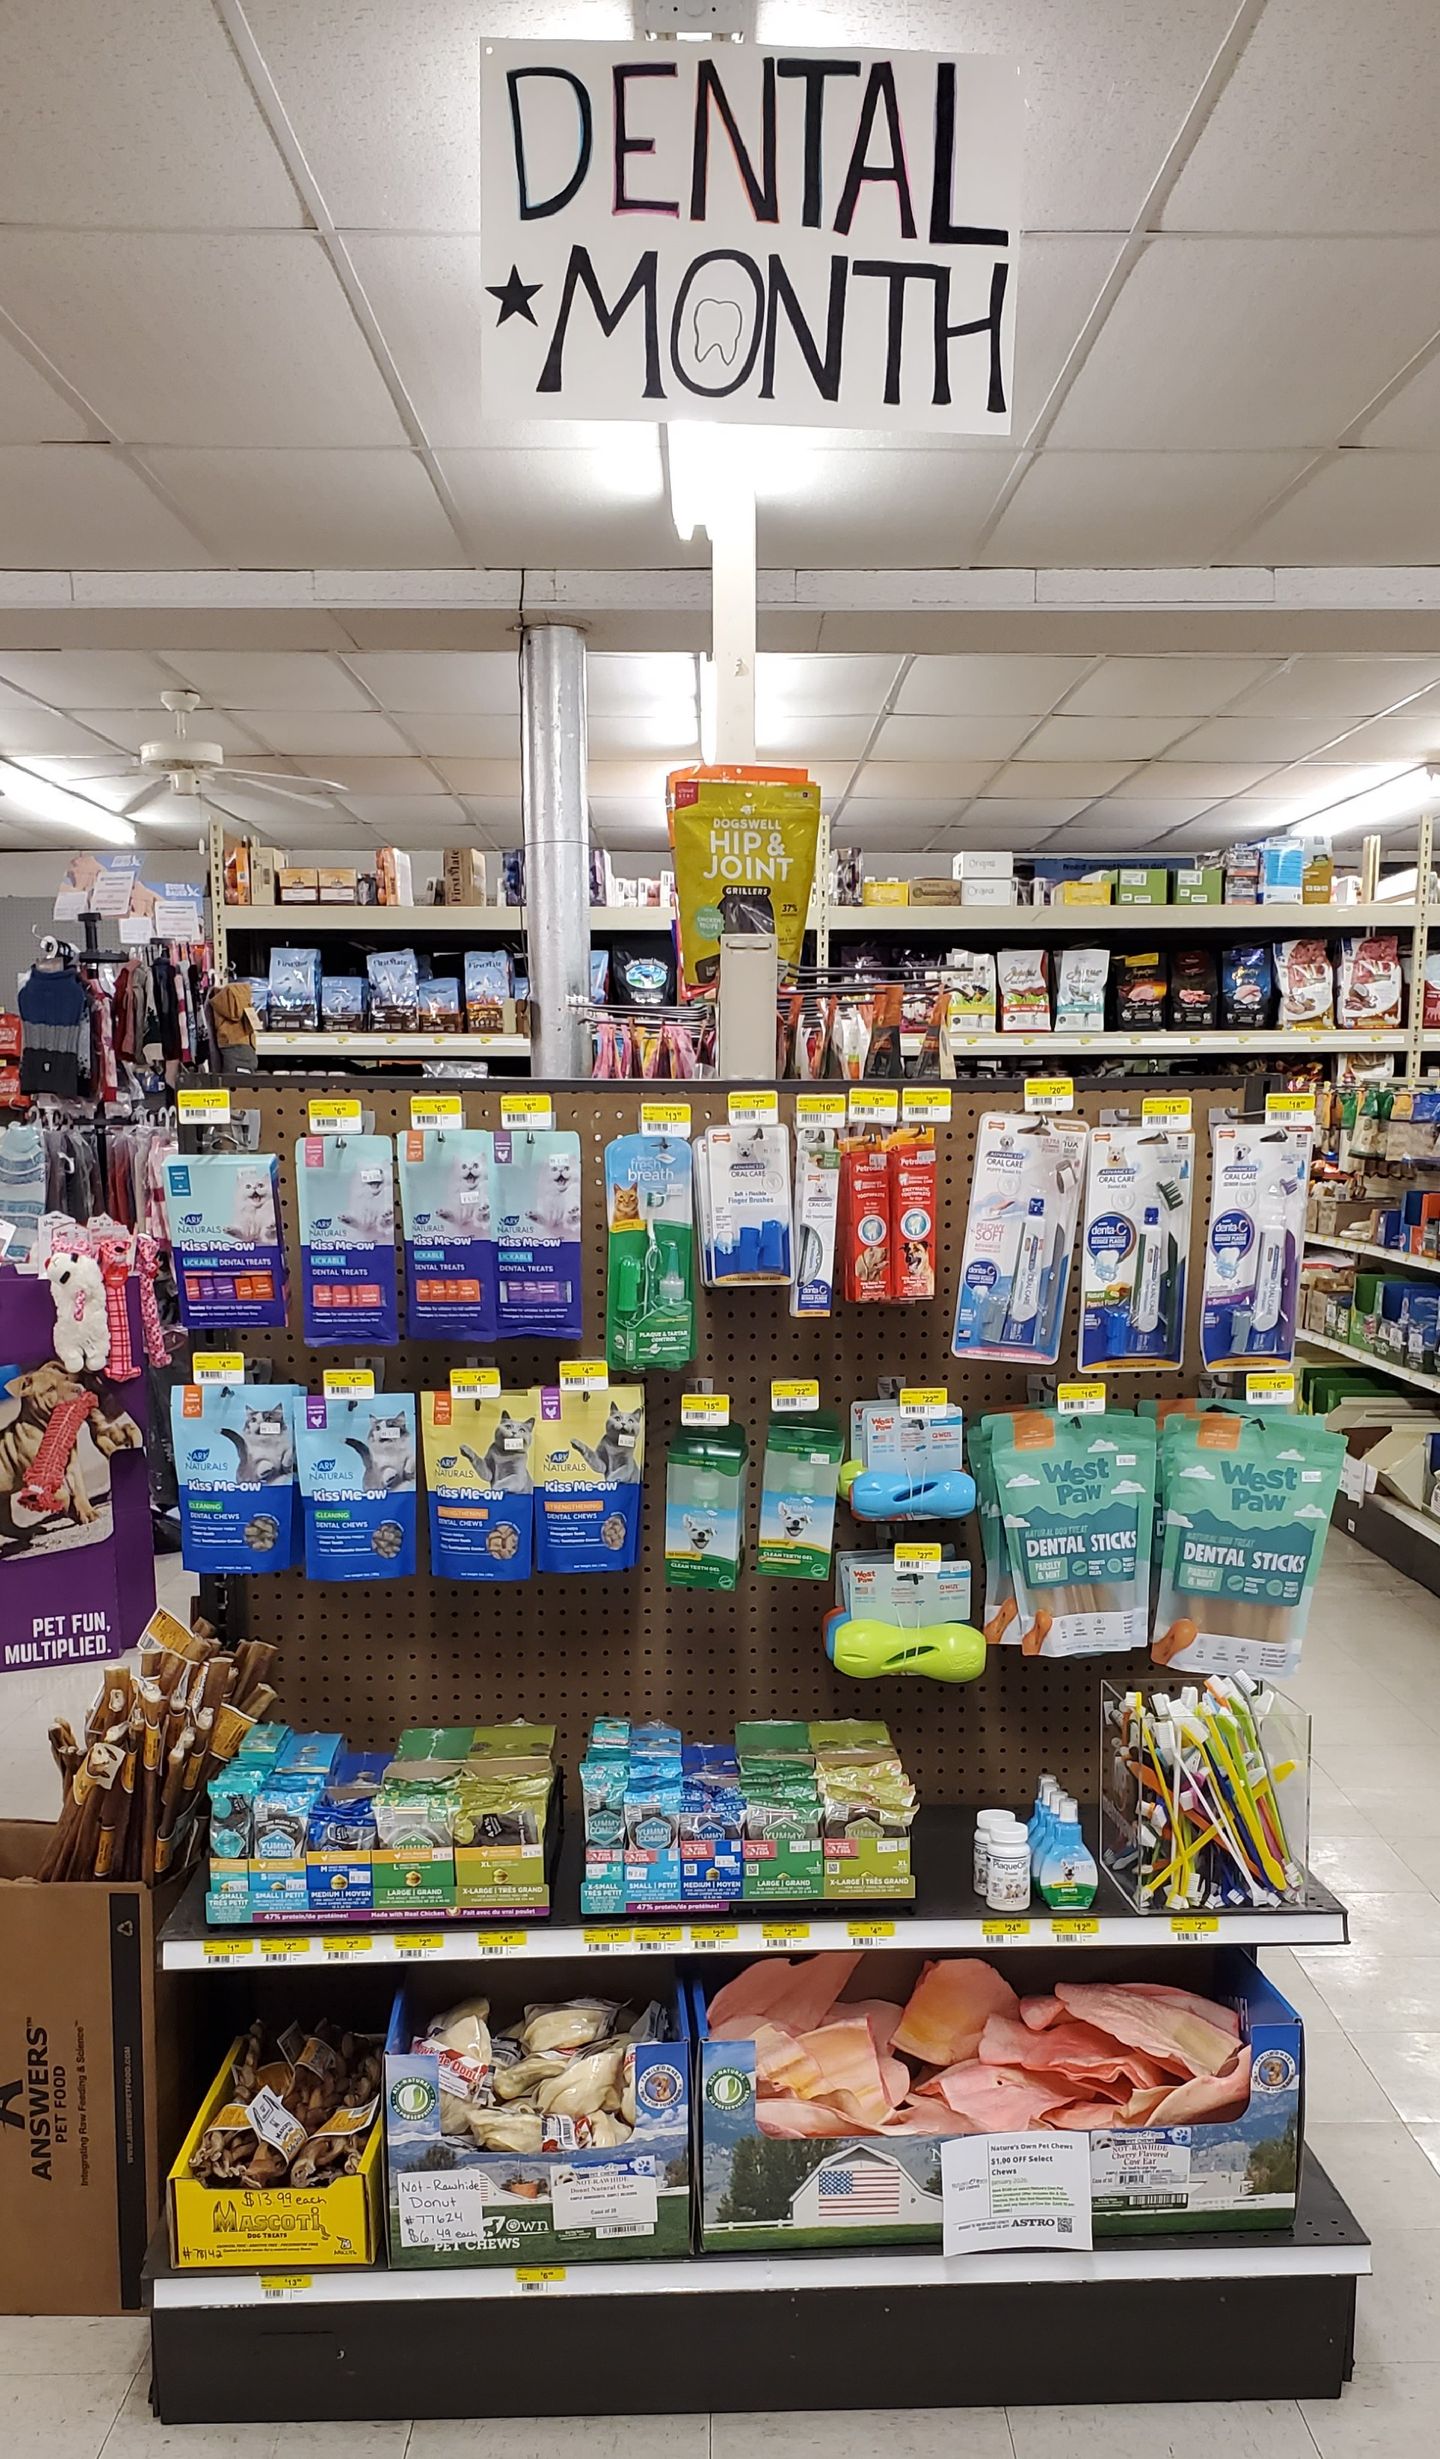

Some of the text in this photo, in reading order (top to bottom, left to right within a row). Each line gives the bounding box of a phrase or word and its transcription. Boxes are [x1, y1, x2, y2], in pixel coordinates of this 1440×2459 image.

[506, 57, 1009, 247] DENTAL
[536, 244, 1009, 414] MONTH
[713, 818, 782, 830] DOGSWELL
[709, 830, 786, 857] HIP &
[703, 855, 794, 881] JOINT
[725, 887, 769, 896] GRILLERS
[631, 1159, 661, 1170] fresh
[987, 1159, 1024, 1169] ORAL CARE
[628, 1168, 674, 1182] breath
[1118, 1175, 1135, 1183] CARE
[1241, 1172, 1257, 1180] CARE
[178, 1225, 221, 1234] NATURALS
[309, 1229, 346, 1237] NATURALS
[413, 1235, 471, 1246] Kiss Me-ow
[975, 1230, 1004, 1242] SOFT
[181, 1240, 255, 1251] Kiss Me-ow
[311, 1240, 375, 1250] Kiss Me-ow
[499, 1237, 560, 1248] Kiss Me-ow
[183, 1258, 271, 1266] LICKABLE DENTAL TREATS
[341, 1268, 368, 1276] TREATS
[871, 1417, 895, 1426] West
[185, 1462, 228, 1471] NATURALS
[544, 1463, 586, 1472] NATURALS
[1041, 1457, 1111, 1485] West
[309, 1471, 353, 1481] NATURALS
[435, 1469, 473, 1478] NATURALS
[1220, 1460, 1298, 1492] West
[188, 1480, 261, 1492] Kiss Me-ow
[545, 1481, 618, 1493] Kiss Me-ow
[313, 1489, 387, 1501] Kiss Me-ow
[437, 1486, 504, 1500] Kiss Me-ow
[1056, 1482, 1102, 1506] Paw
[1230, 1488, 1289, 1513] Paw
[545, 1503, 603, 1511] STRENGTHENING
[190, 1512, 240, 1520] DENTAL CHEWS
[316, 1521, 339, 1529] DENTAL
[1026, 1530, 1137, 1558] DENTAL STICKS
[1183, 1542, 1306, 1574] DENTAL STICKS
[1034, 1561, 1062, 1573] PARSLEY
[1187, 1567, 1217, 1580] PARSLEY
[32, 1612, 111, 1638] PET FUN,
[4, 1634, 112, 1665] MULTIPLIED.
[637, 1828, 668, 1836] YUMMY
[764, 1831, 804, 1840] YUMMY
[261, 1842, 293, 1850] YUMMY
[629, 1882, 652, 1890] SMALL
[683, 1881, 741, 1889] MEDIUM MOYEN
[757, 1879, 811, 1887] LARGE GRAND
[829, 1878, 860, 1886] X-LARGE
[884, 1878, 909, 1886] GRAND
[255, 1891, 305, 1899] SMALL PETIT
[311, 1890, 340, 1898] MEDIUM
[462, 1887, 493, 1895] X-LARGE
[404, 1910, 419, 1918] Real
[420, 1909, 445, 1917] Chicken
[76, 2065, 85, 2073] &
[77, 2074, 88, 2112] Feeding
[53, 2065, 68, 2143] PET FOOD
[78, 2113, 87, 2135] Raw
[991, 2142, 1074, 2152] Nature's Own Pet Chews
[991, 2154, 1054, 2166] $1.00 OFF Select
[1112, 2150, 1170, 2161] Cherry Flavored
[79, 2136, 90, 2187] Integrating
[1123, 2157, 1157, 2166] Cow Ear
[991, 2168, 1018, 2177] Chews
[401, 2181, 423, 2193] Not
[433, 2178, 480, 2192] Rawhide
[295, 2196, 328, 2206] each
[408, 2196, 457, 2209] Donut
[403, 2212, 464, 2226] #77624
[1010, 2217, 1056, 2228] ASTRO
[506, 2218, 550, 2233] Own
[247, 2231, 288, 2240] DOG TREATS
[465, 2236, 520, 2251] CHEWS
